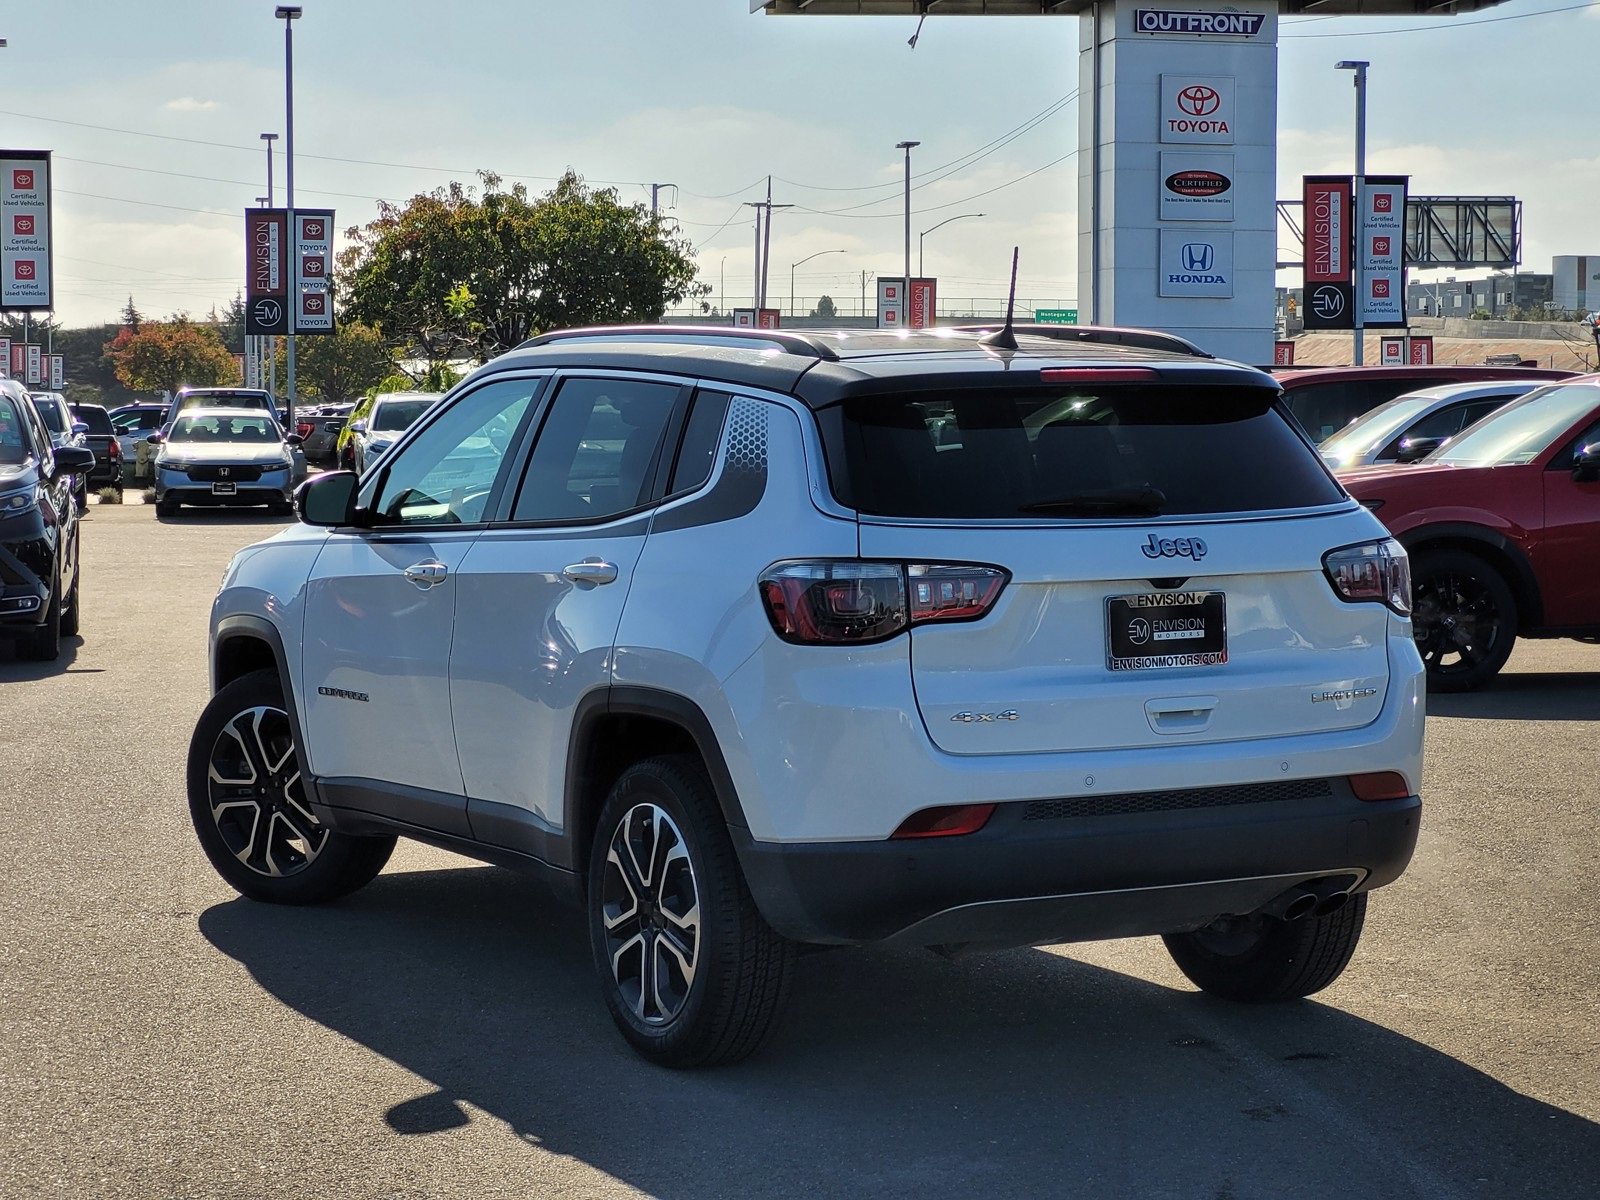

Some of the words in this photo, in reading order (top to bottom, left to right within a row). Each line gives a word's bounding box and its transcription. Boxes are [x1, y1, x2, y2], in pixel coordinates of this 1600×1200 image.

[1142, 12, 1259, 33] OUTFRONT
[1168, 119, 1229, 134] TOYOTA
[1173, 179, 1223, 187] CERTIFIED
[1314, 191, 1330, 274] ENVISION
[256, 221, 269, 290] ENVISION
[1168, 274, 1227, 284] HONDA
[1140, 533, 1208, 561] Jeep
[1137, 592, 1196, 607] ENVISION
[1152, 618, 1205, 632] ENVISION
[1157, 631, 1201, 639] MOTORS
[1112, 652, 1224, 670] ENVISIONMOTORS.COM
